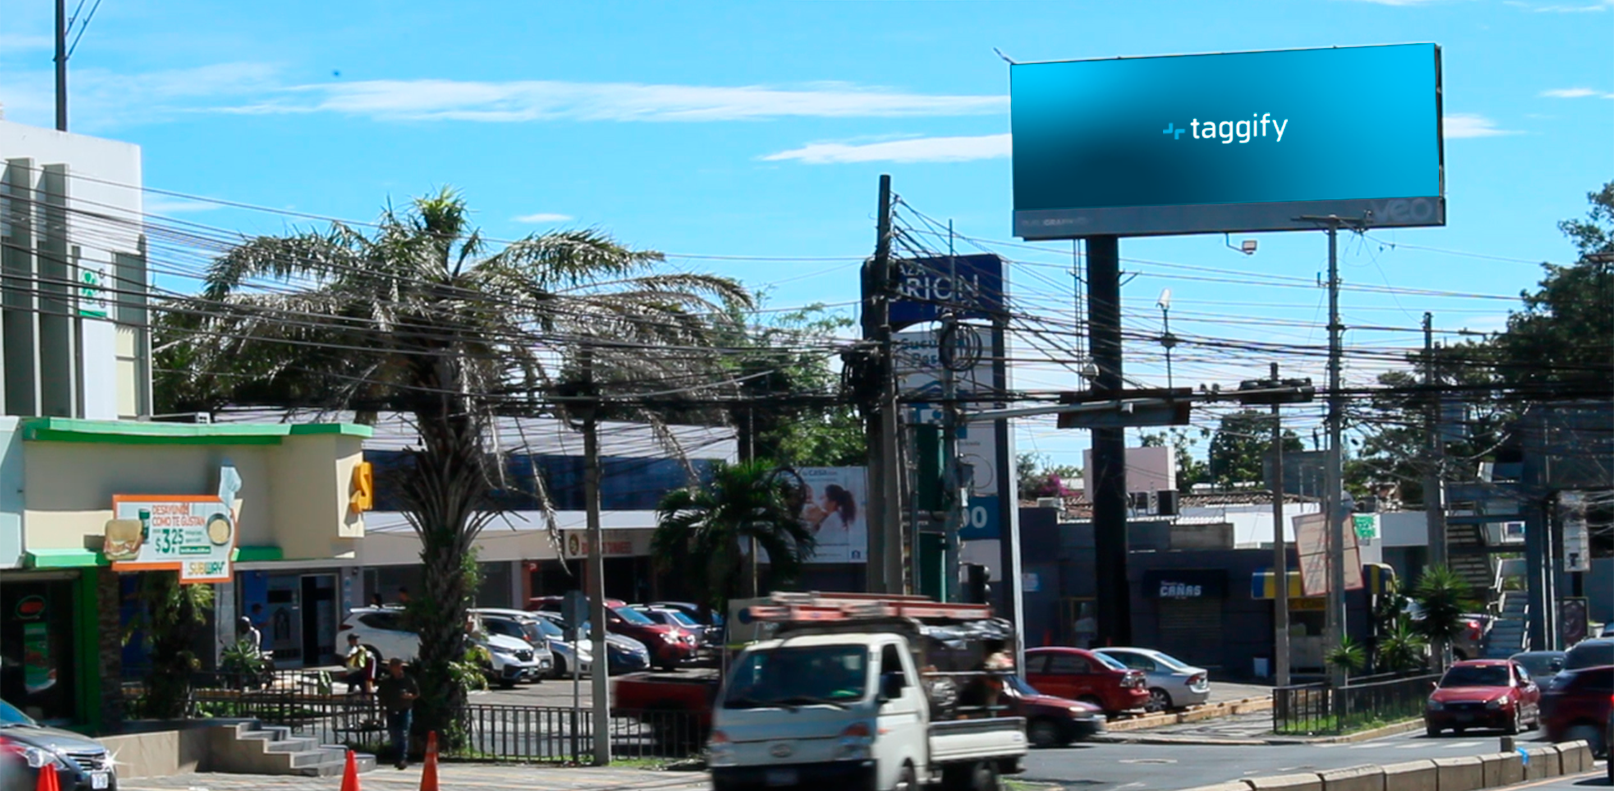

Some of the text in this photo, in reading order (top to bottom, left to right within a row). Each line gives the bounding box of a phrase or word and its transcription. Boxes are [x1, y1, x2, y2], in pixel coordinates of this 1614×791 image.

[1190, 112, 1289, 144] taggify
[153, 516, 205, 526] COMO TE GUSTAN
[188, 562, 225, 575] SUBWAY
